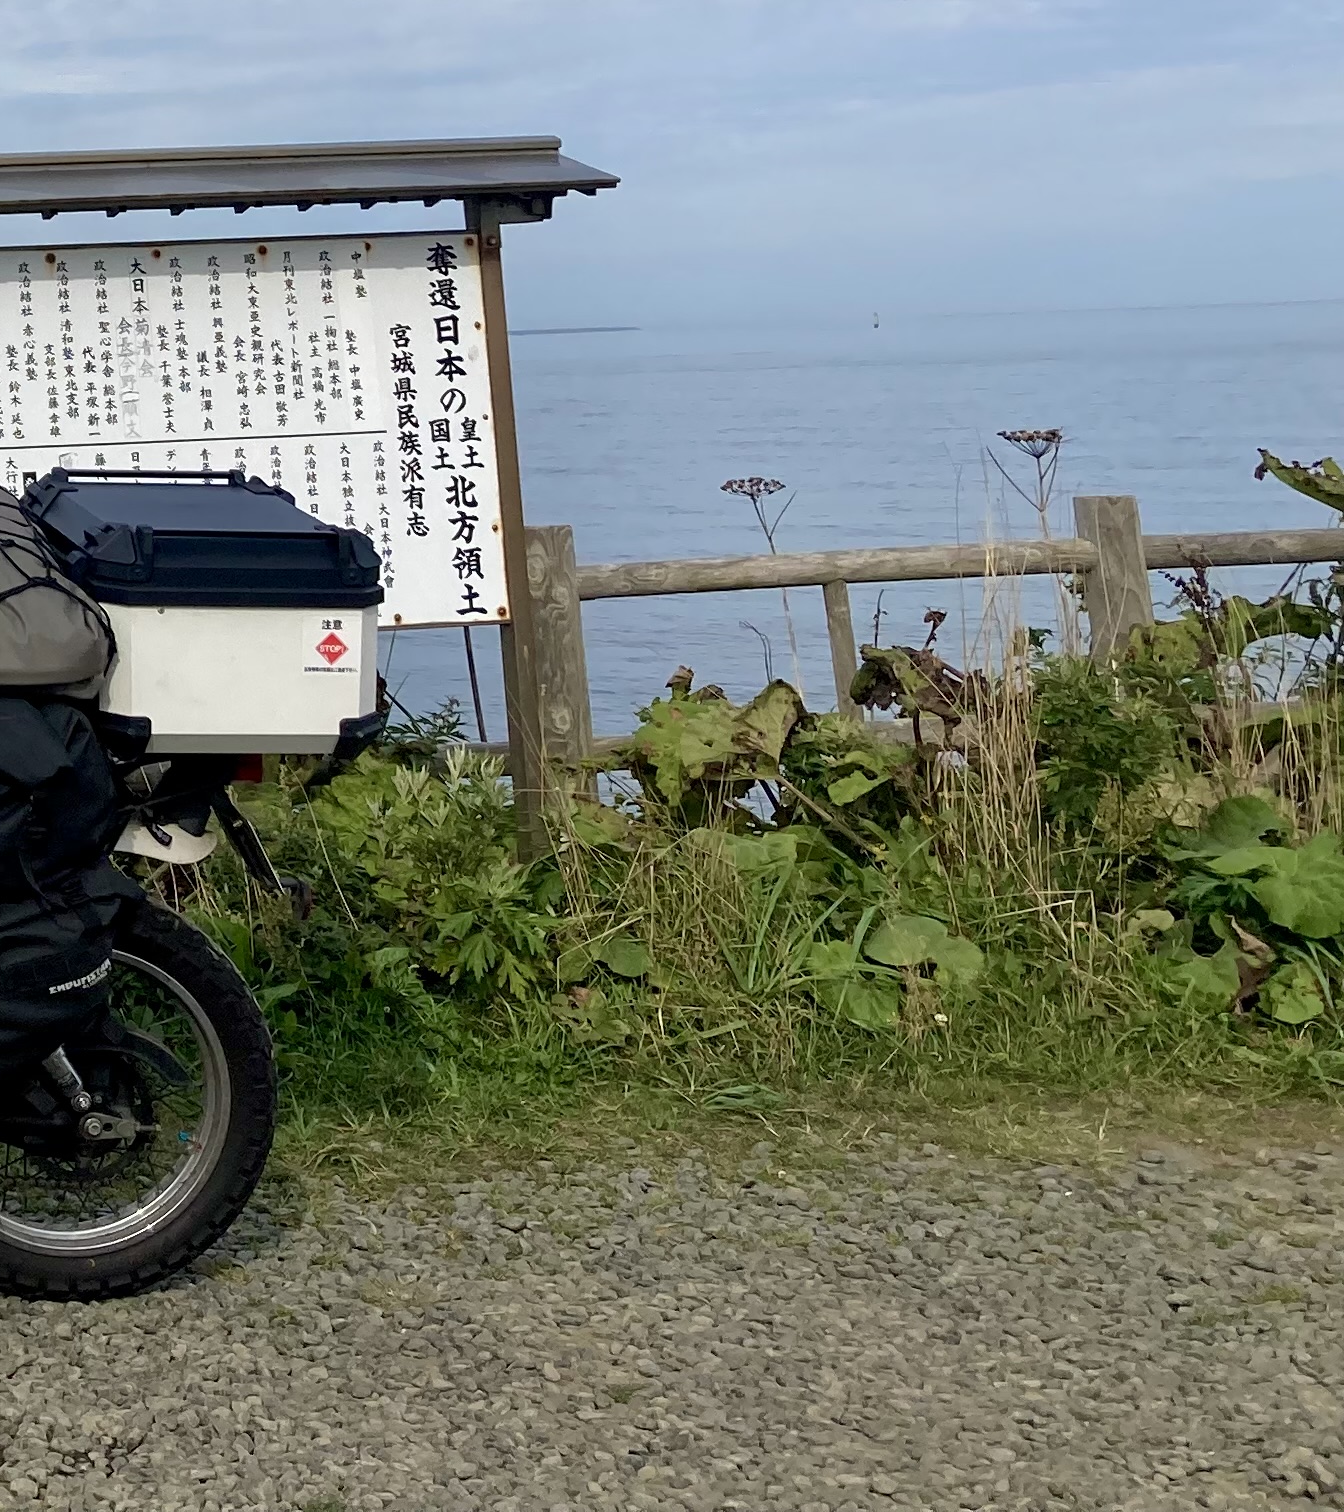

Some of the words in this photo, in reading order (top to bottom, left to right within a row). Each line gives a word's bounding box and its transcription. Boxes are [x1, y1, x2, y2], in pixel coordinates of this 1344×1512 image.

[426, 242, 467, 414] 奪還日本の
[389, 323, 430, 538] 宮城県民族派有志
[429, 418, 456, 471] 国土
[446, 475, 488, 617] 北方領土
